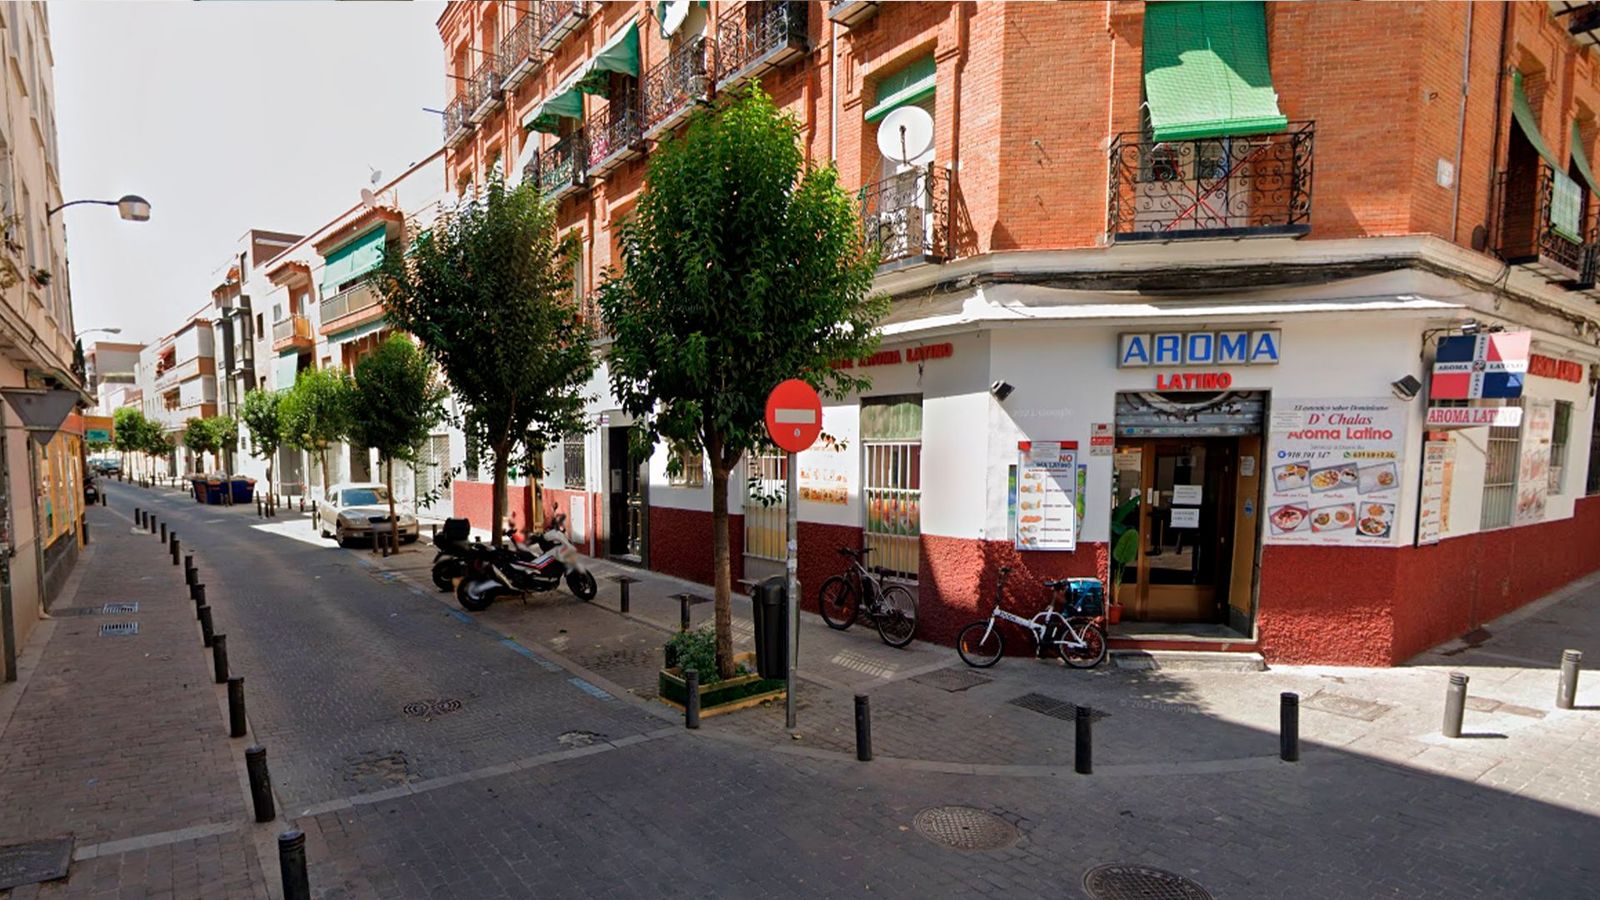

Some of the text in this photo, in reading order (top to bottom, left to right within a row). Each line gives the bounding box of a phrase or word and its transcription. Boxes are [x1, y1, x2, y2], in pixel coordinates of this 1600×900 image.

[1123, 333, 1278, 363] AROMA
[1156, 373, 1232, 390] LATINO
[1328, 412, 1373, 425] Chalas
[1428, 409, 1470, 423] AROMA
[1346, 427, 1393, 440] Latino
